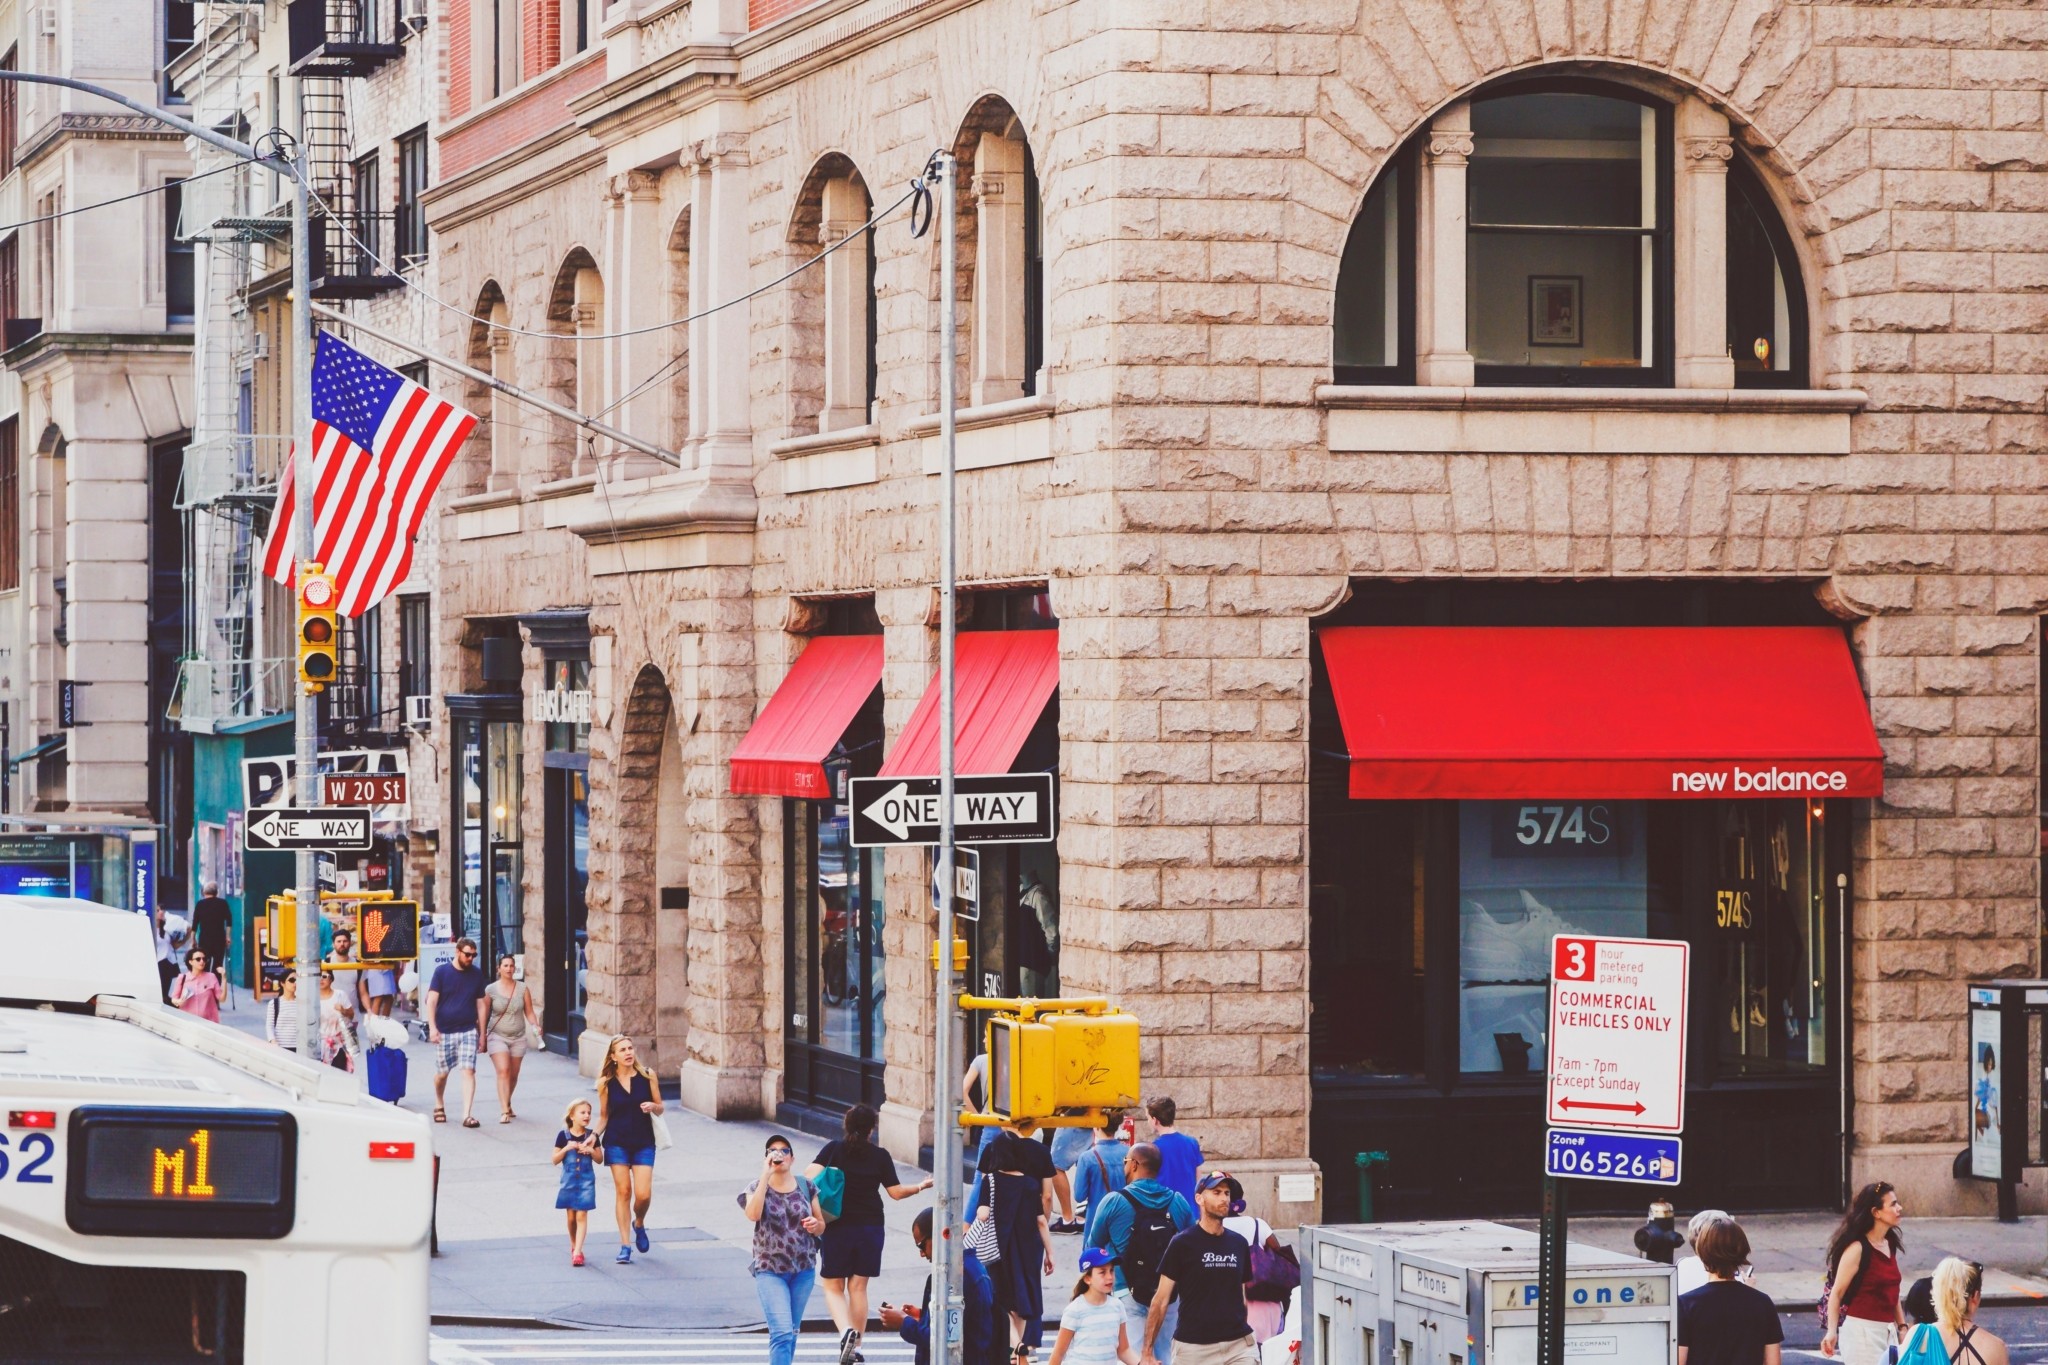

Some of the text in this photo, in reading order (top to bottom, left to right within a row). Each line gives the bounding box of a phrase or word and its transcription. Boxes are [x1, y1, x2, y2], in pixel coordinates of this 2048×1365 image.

[64, 684, 72, 725] AVEDA
[1672, 766, 1848, 792] new balance
[331, 780, 400, 801] W 20 St
[884, 796, 1025, 824] ONE WAY
[264, 821, 359, 837] ONE WAY
[1516, 805, 1610, 845] 574S
[137, 859, 147, 867] 5
[370, 867, 386, 877] OPEN
[136, 868, 147, 908] Avenue
[960, 870, 975, 898] WAY
[463, 891, 481, 919] SALE
[1717, 890, 1752, 929] 574S
[1564, 942, 1587, 978] 3
[1601, 948, 1624, 960] hour
[1600, 961, 1644, 973] metered
[1600, 973, 1638, 987] parking
[1560, 991, 1657, 1011] COMMERCIAL
[1560, 1011, 1672, 1032] VEHICLES ONLY
[1557, 1057, 1581, 1071] 7am
[1593, 1059, 1618, 1074] 7pm
[1556, 1074, 1640, 1094] Except Sunday
[1552, 1134, 1585, 1146] Zone#
[1552, 1148, 1646, 1177] 106526
[1201, 1252, 1238, 1263] Bark
[1417, 1270, 1446, 1294] Phone
[1524, 1285, 1635, 1305] Pone
